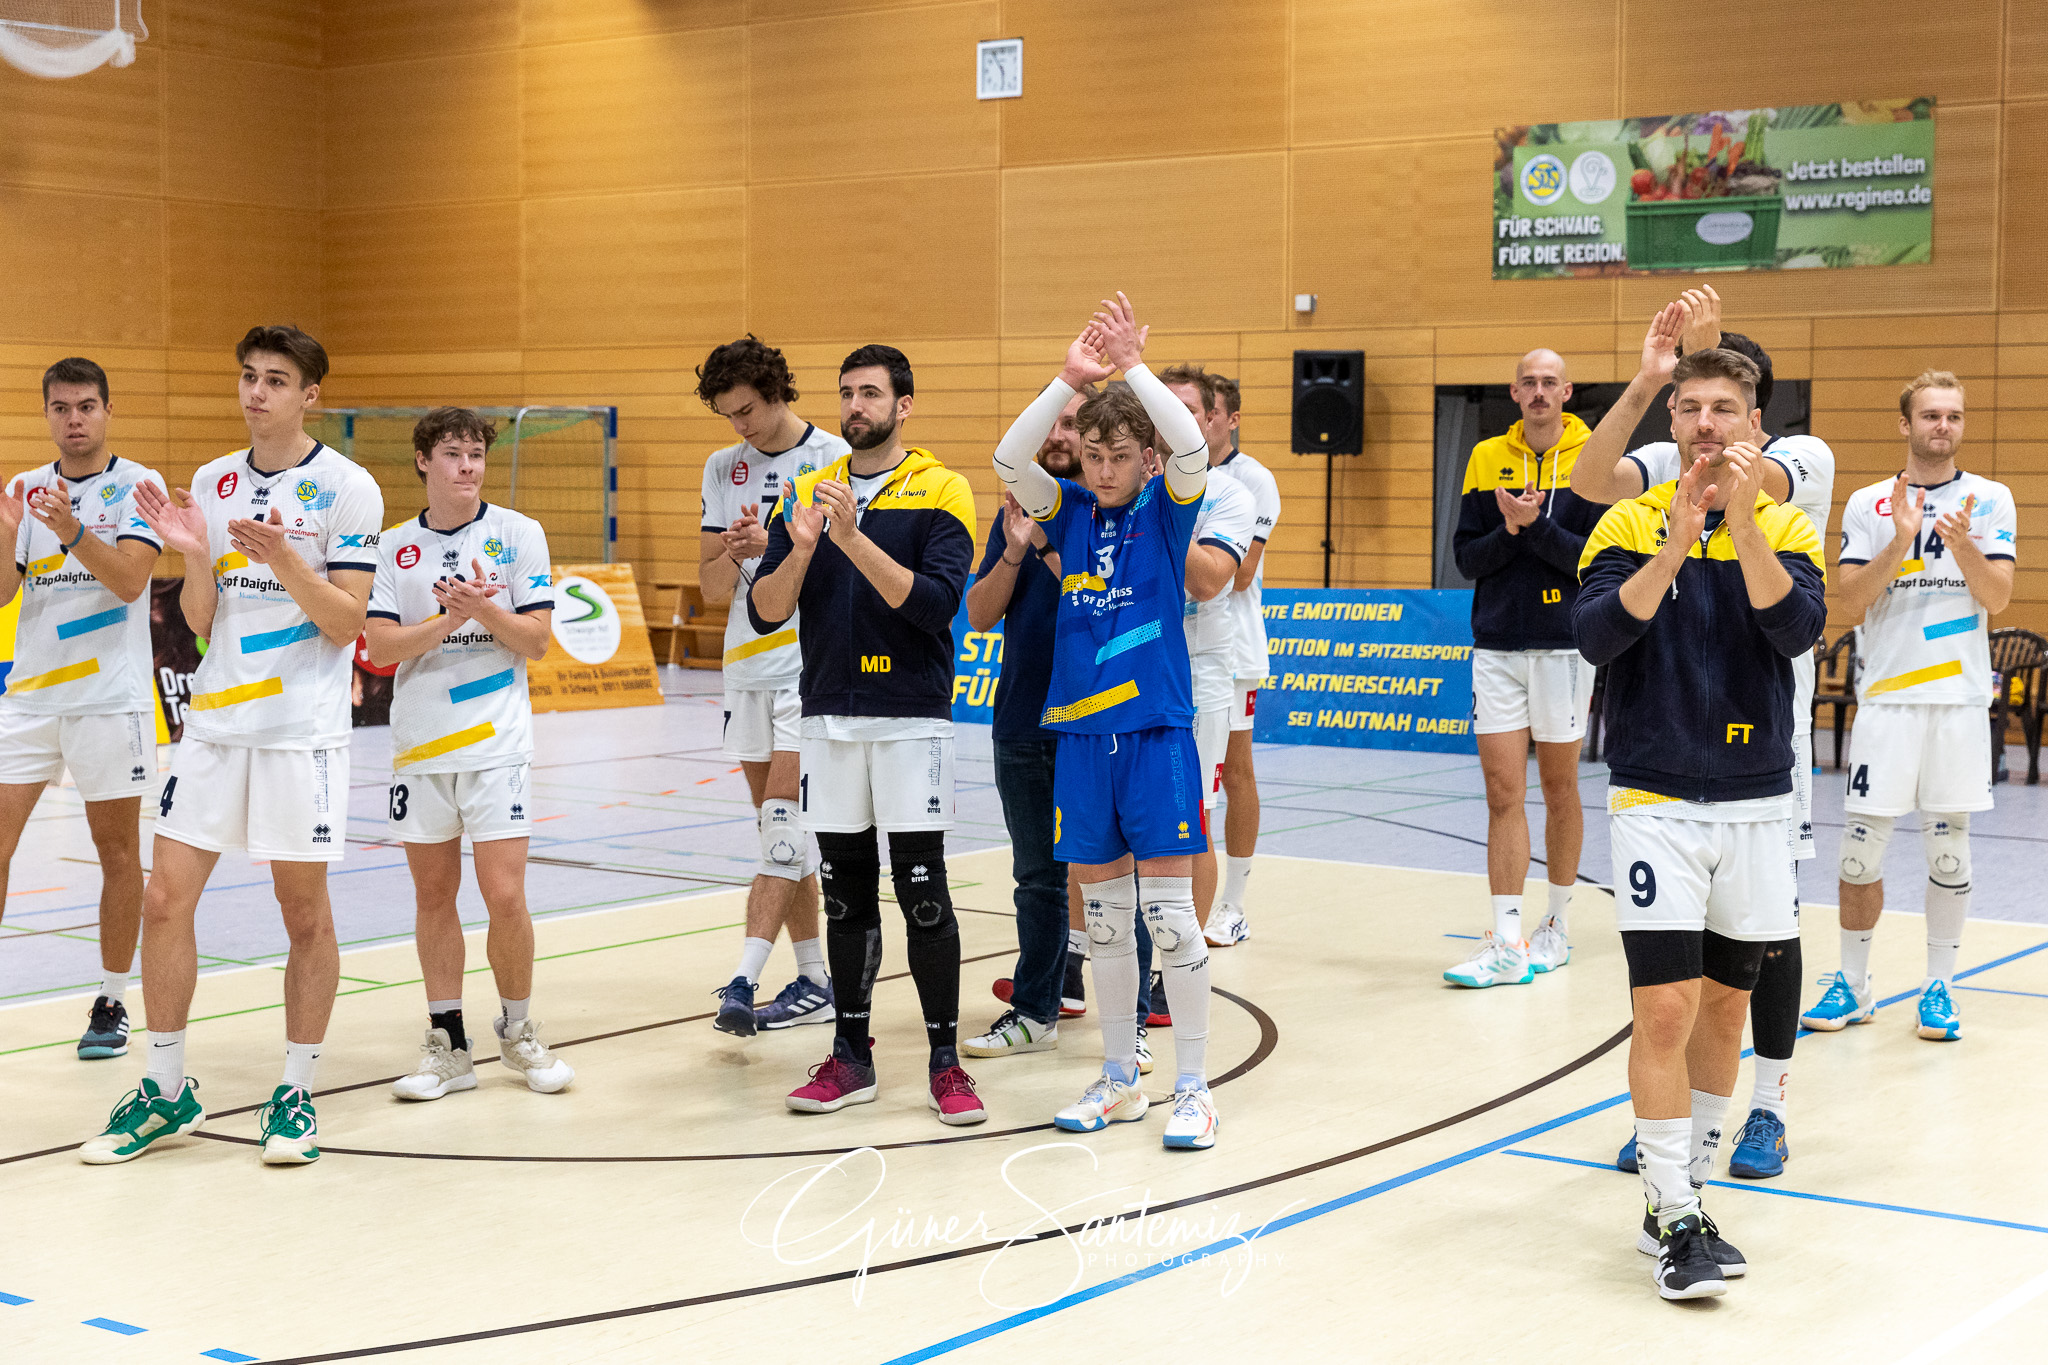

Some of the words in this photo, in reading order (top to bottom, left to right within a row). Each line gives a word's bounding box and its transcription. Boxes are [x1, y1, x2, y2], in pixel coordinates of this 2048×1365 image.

[1786, 159, 1837, 181] Jetzt
[1841, 154, 1926, 178] bestellen
[1784, 184, 1932, 211] www.regineo.de
[1499, 215, 1532, 238] FÜR
[1498, 243, 1531, 266] FÜR
[1534, 245, 1561, 265] DIE
[1563, 242, 1627, 264] REGION.
[761, 495, 779, 531] 7
[1256, 516, 1272, 526] puls
[1913, 529, 1945, 560] 14
[1096, 545, 1114, 579] 3
[36, 575, 54, 586] Zap
[54, 572, 96, 583] Daigfus
[240, 577, 287, 592] Daigfus
[1893, 578, 1917, 589] Zapf
[1919, 577, 1966, 588] Daigfuss
[1542, 589, 1561, 604] LD
[1262, 604, 1289, 619] HTE
[1292, 602, 1403, 621] EMOTIONEN
[442, 632, 494, 645] Daigfuss
[1267, 637, 1331, 657] DITION
[1333, 642, 1355, 658] IM
[1358, 642, 1473, 661] SPITZENSPORT
[861, 655, 891, 673] MD
[1281, 673, 1444, 696] PARTNERSCHAFT
[1287, 711, 1312, 727] SEI
[1317, 710, 1412, 732] HAUTNAH
[1726, 722, 1754, 744] FT
[160, 775, 178, 817] 4
[312, 835, 331, 843] errea
[911, 874, 929, 883] errea
[1629, 860, 1657, 908] 9
